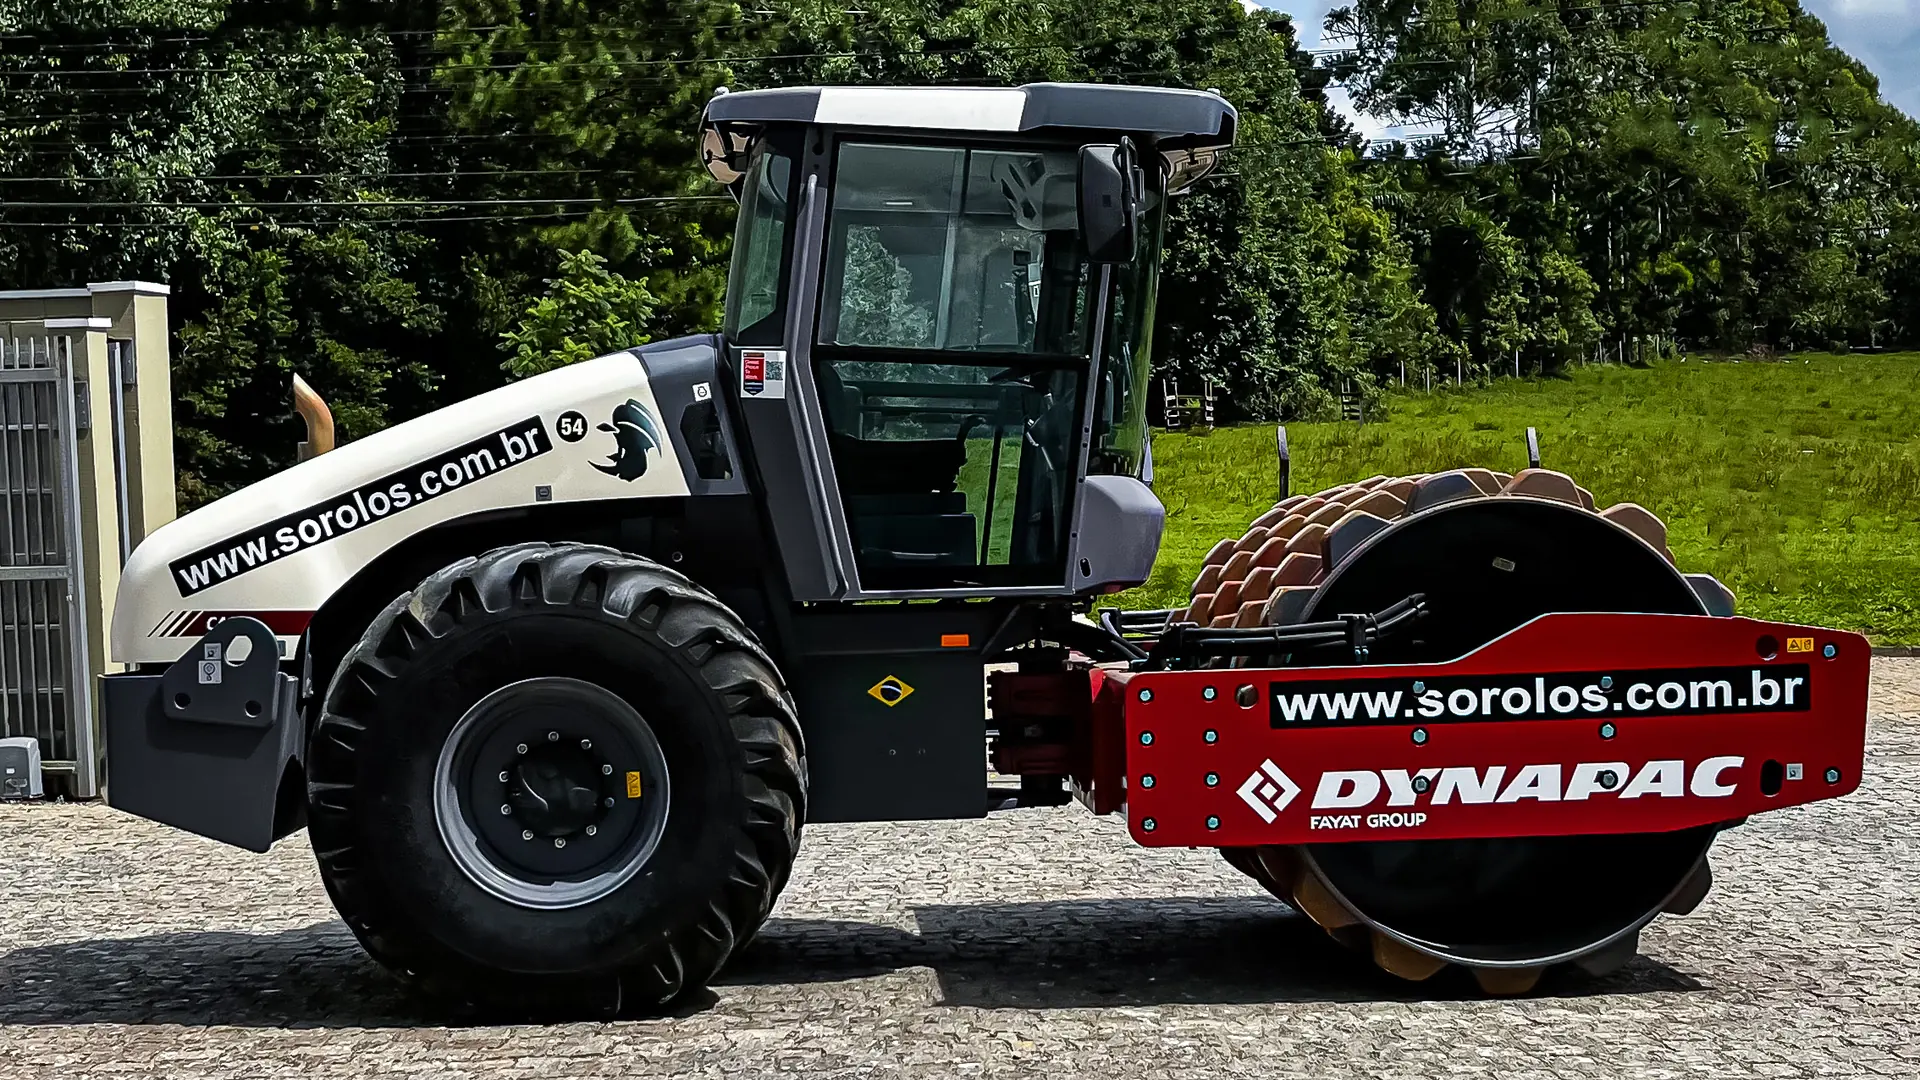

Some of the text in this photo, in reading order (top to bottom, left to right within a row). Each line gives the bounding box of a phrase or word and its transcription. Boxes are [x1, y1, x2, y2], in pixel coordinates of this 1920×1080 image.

[561, 418, 584, 436] 54
[179, 427, 539, 590] www.sorolos.com.br
[1277, 669, 1804, 721] www.sorolos.com.br
[1310, 756, 1745, 809] DYNAPAC
[1310, 812, 1427, 830] FAYAT GROUP
